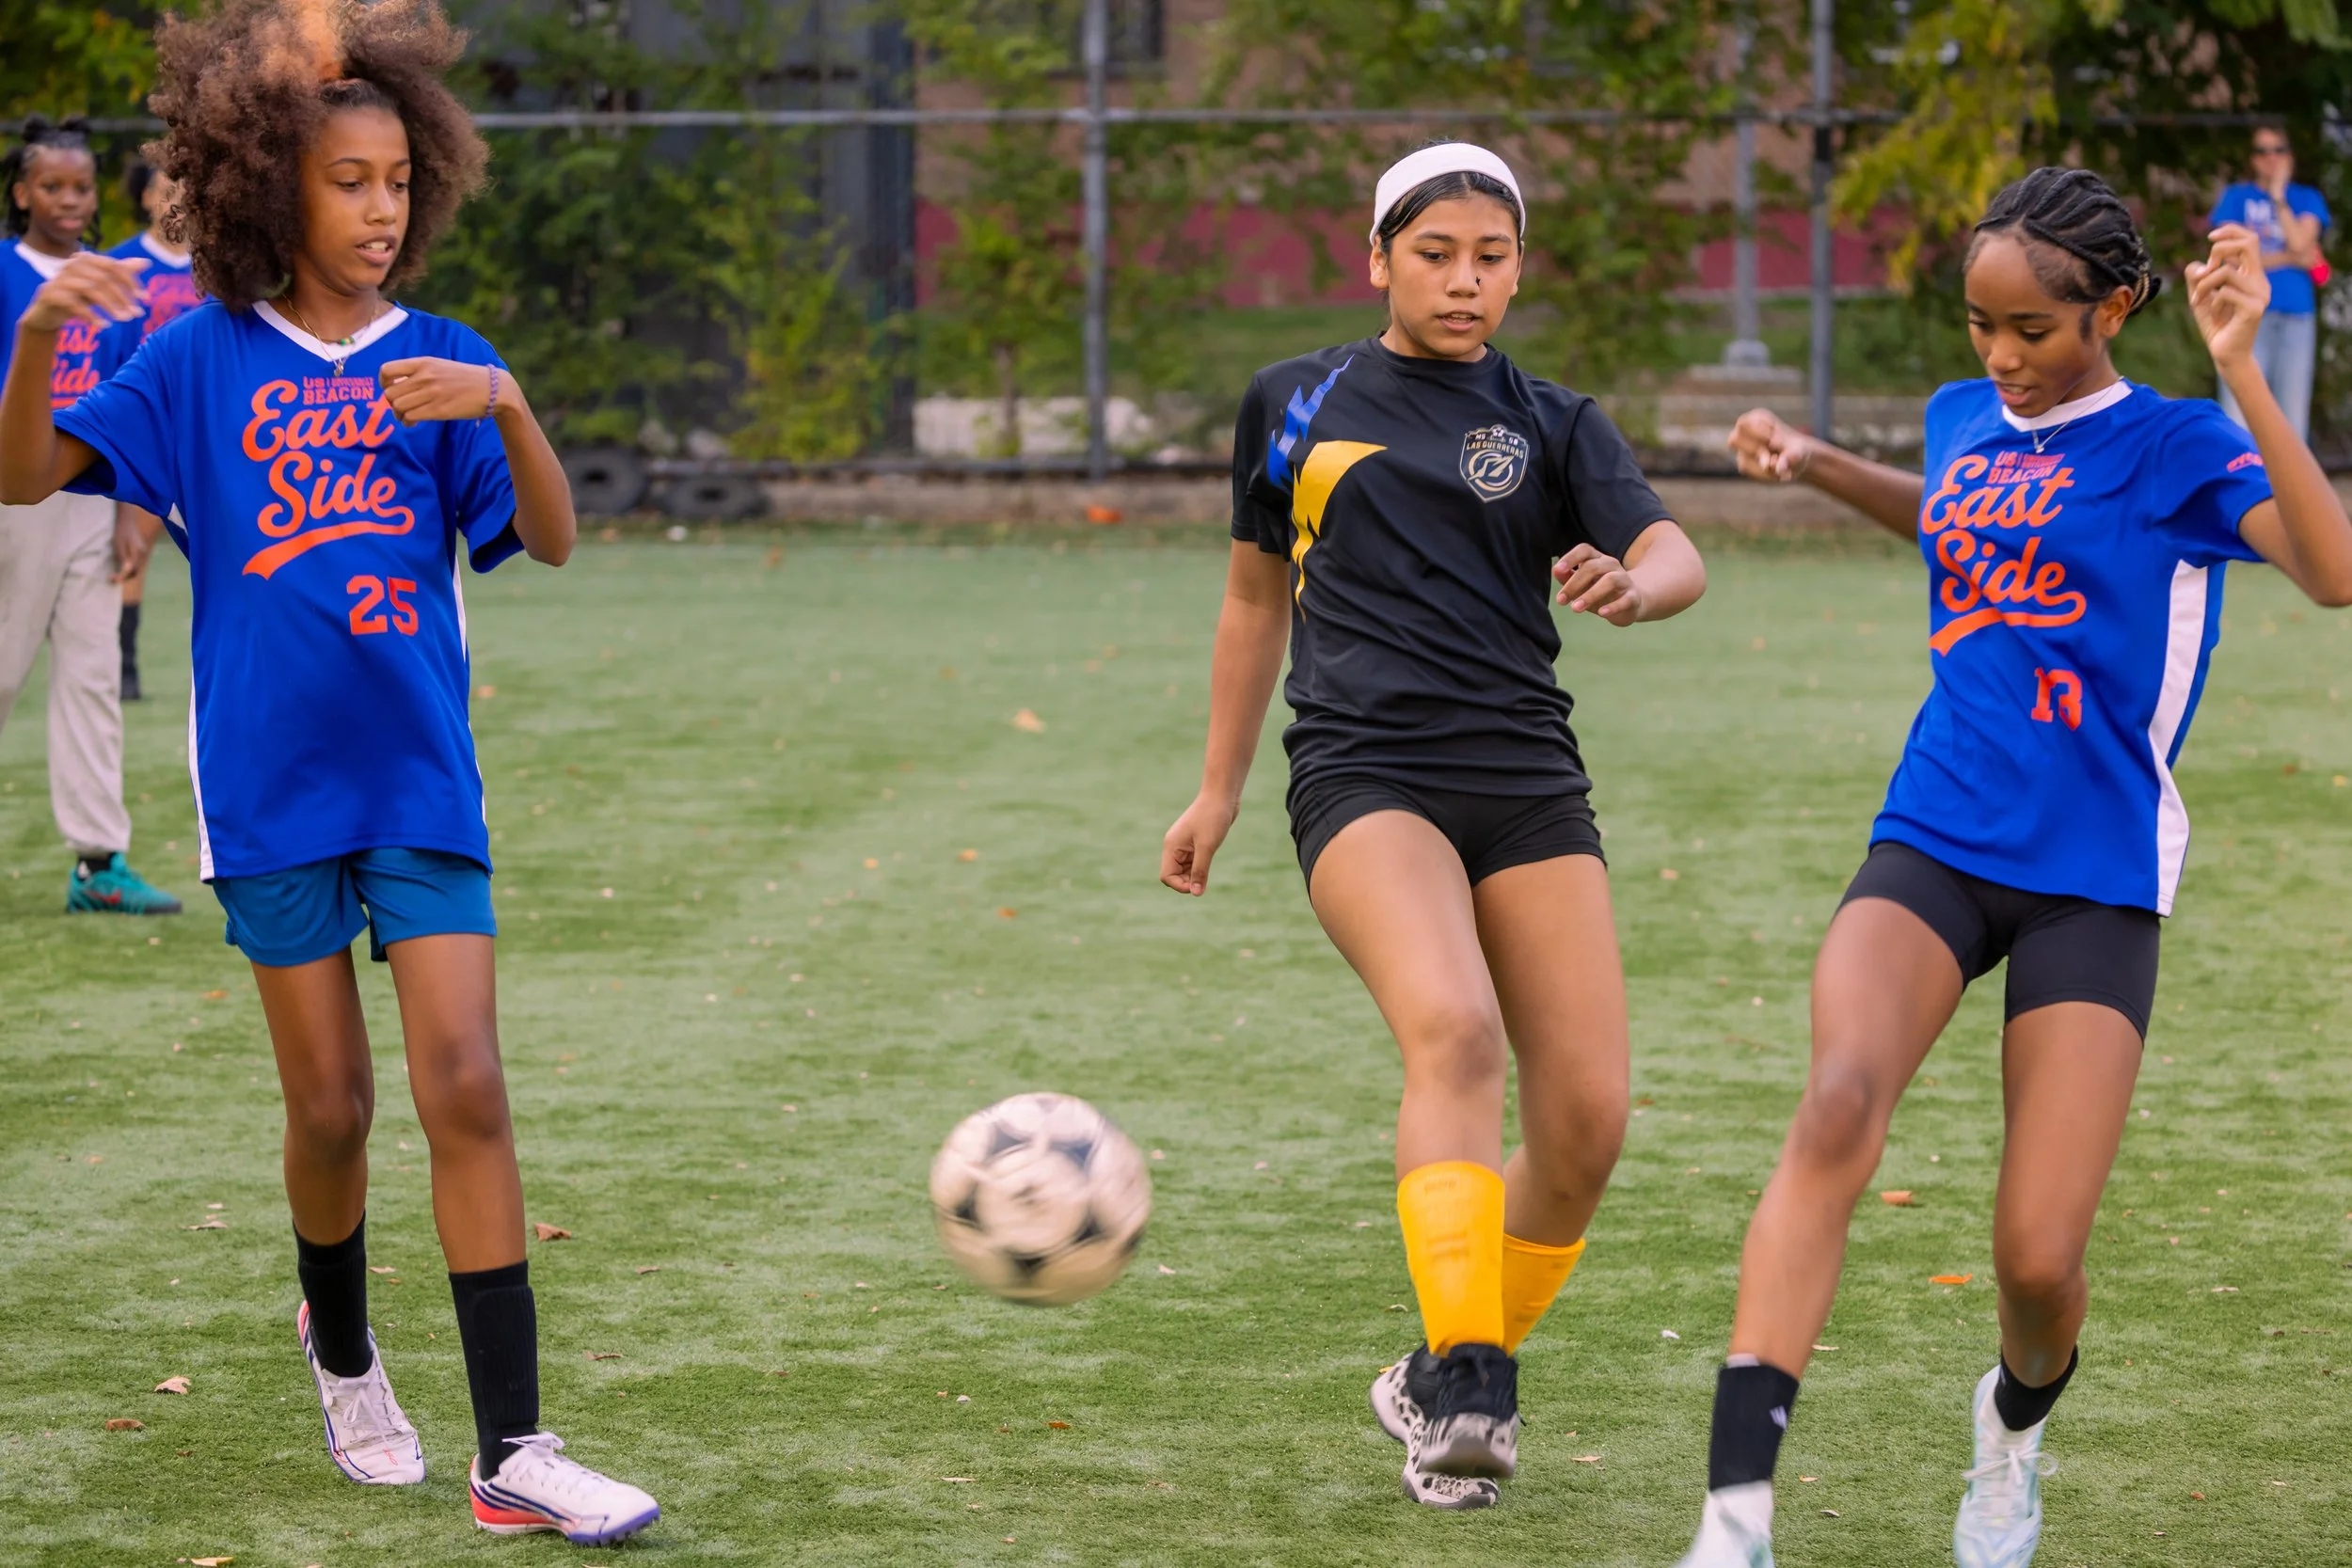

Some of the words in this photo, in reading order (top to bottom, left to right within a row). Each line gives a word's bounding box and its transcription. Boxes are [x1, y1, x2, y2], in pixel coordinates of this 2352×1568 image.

[51, 356, 101, 393] ide
[303, 387, 373, 405] BEACON
[242, 379, 395, 462] East
[1467, 441, 1481, 451] LAS
[1482, 441, 1523, 459] GUERRERAS
[257, 451, 415, 539] Side
[1921, 454, 2074, 534] East
[1986, 465, 2058, 483] BEACON
[346, 575, 419, 636] 25
[1936, 529, 2087, 626] Side
[2031, 667, 2082, 731] 13
